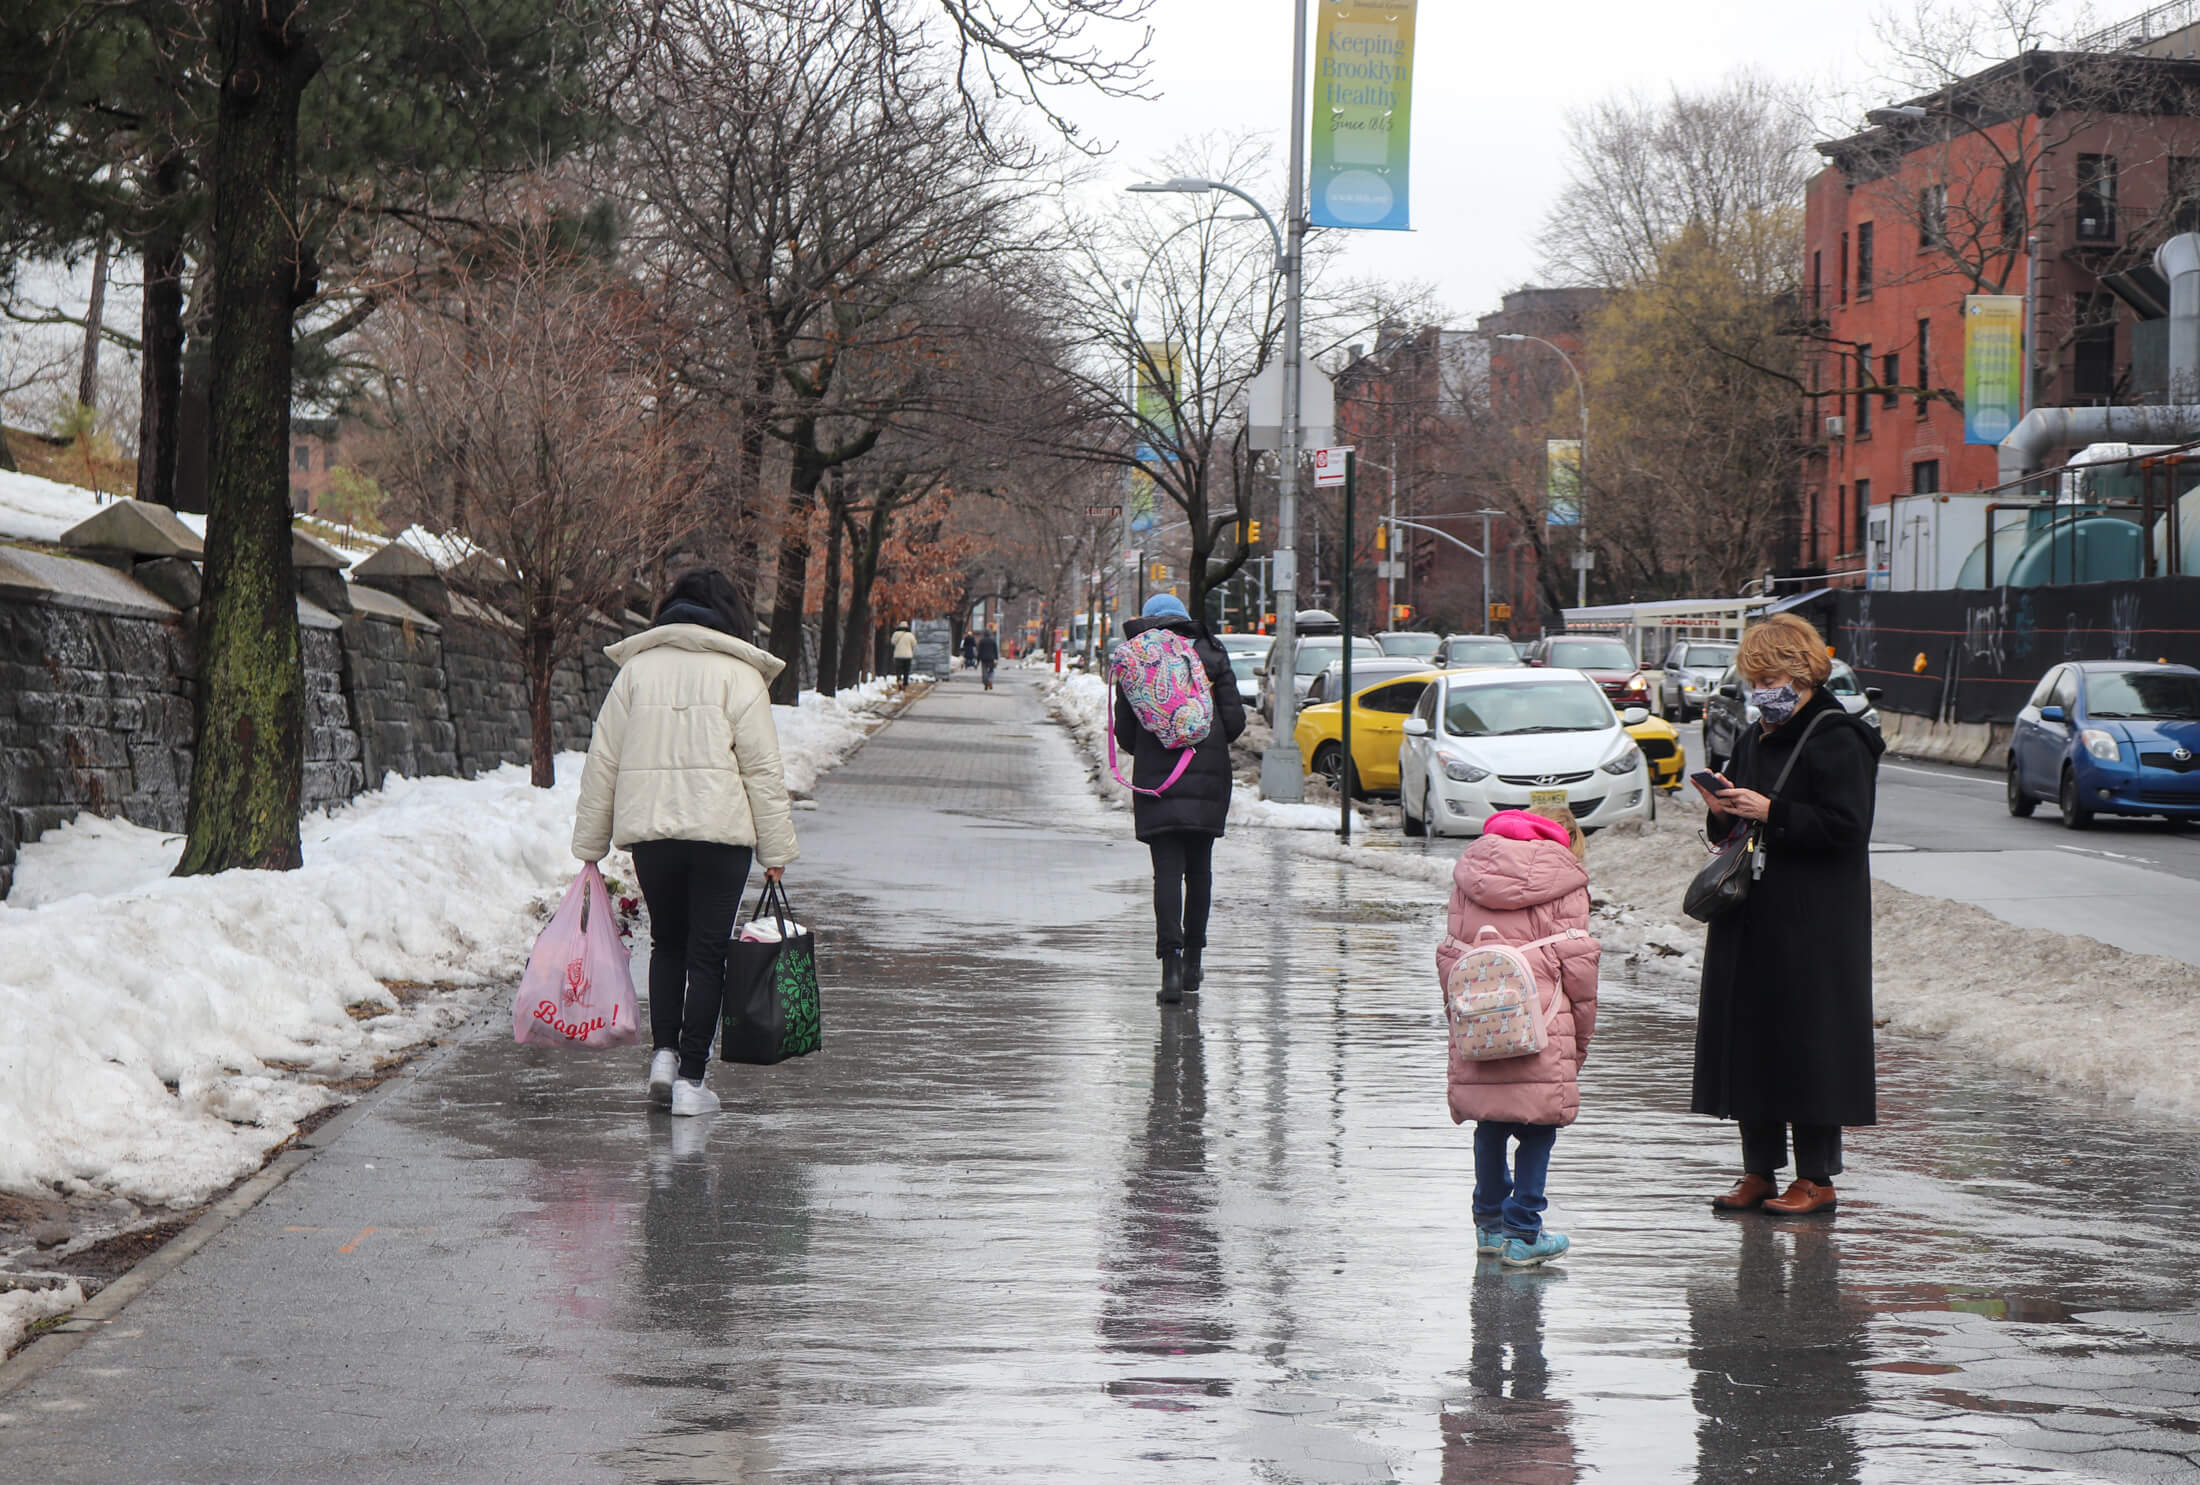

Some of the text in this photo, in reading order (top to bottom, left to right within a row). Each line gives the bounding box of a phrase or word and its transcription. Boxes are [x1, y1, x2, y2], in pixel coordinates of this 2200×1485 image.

[1328, 31, 1405, 57] Keeping
[1322, 56, 1407, 84] Brooklyn
[1327, 83, 1399, 110] Healthy
[1329, 112, 1365, 132] Since
